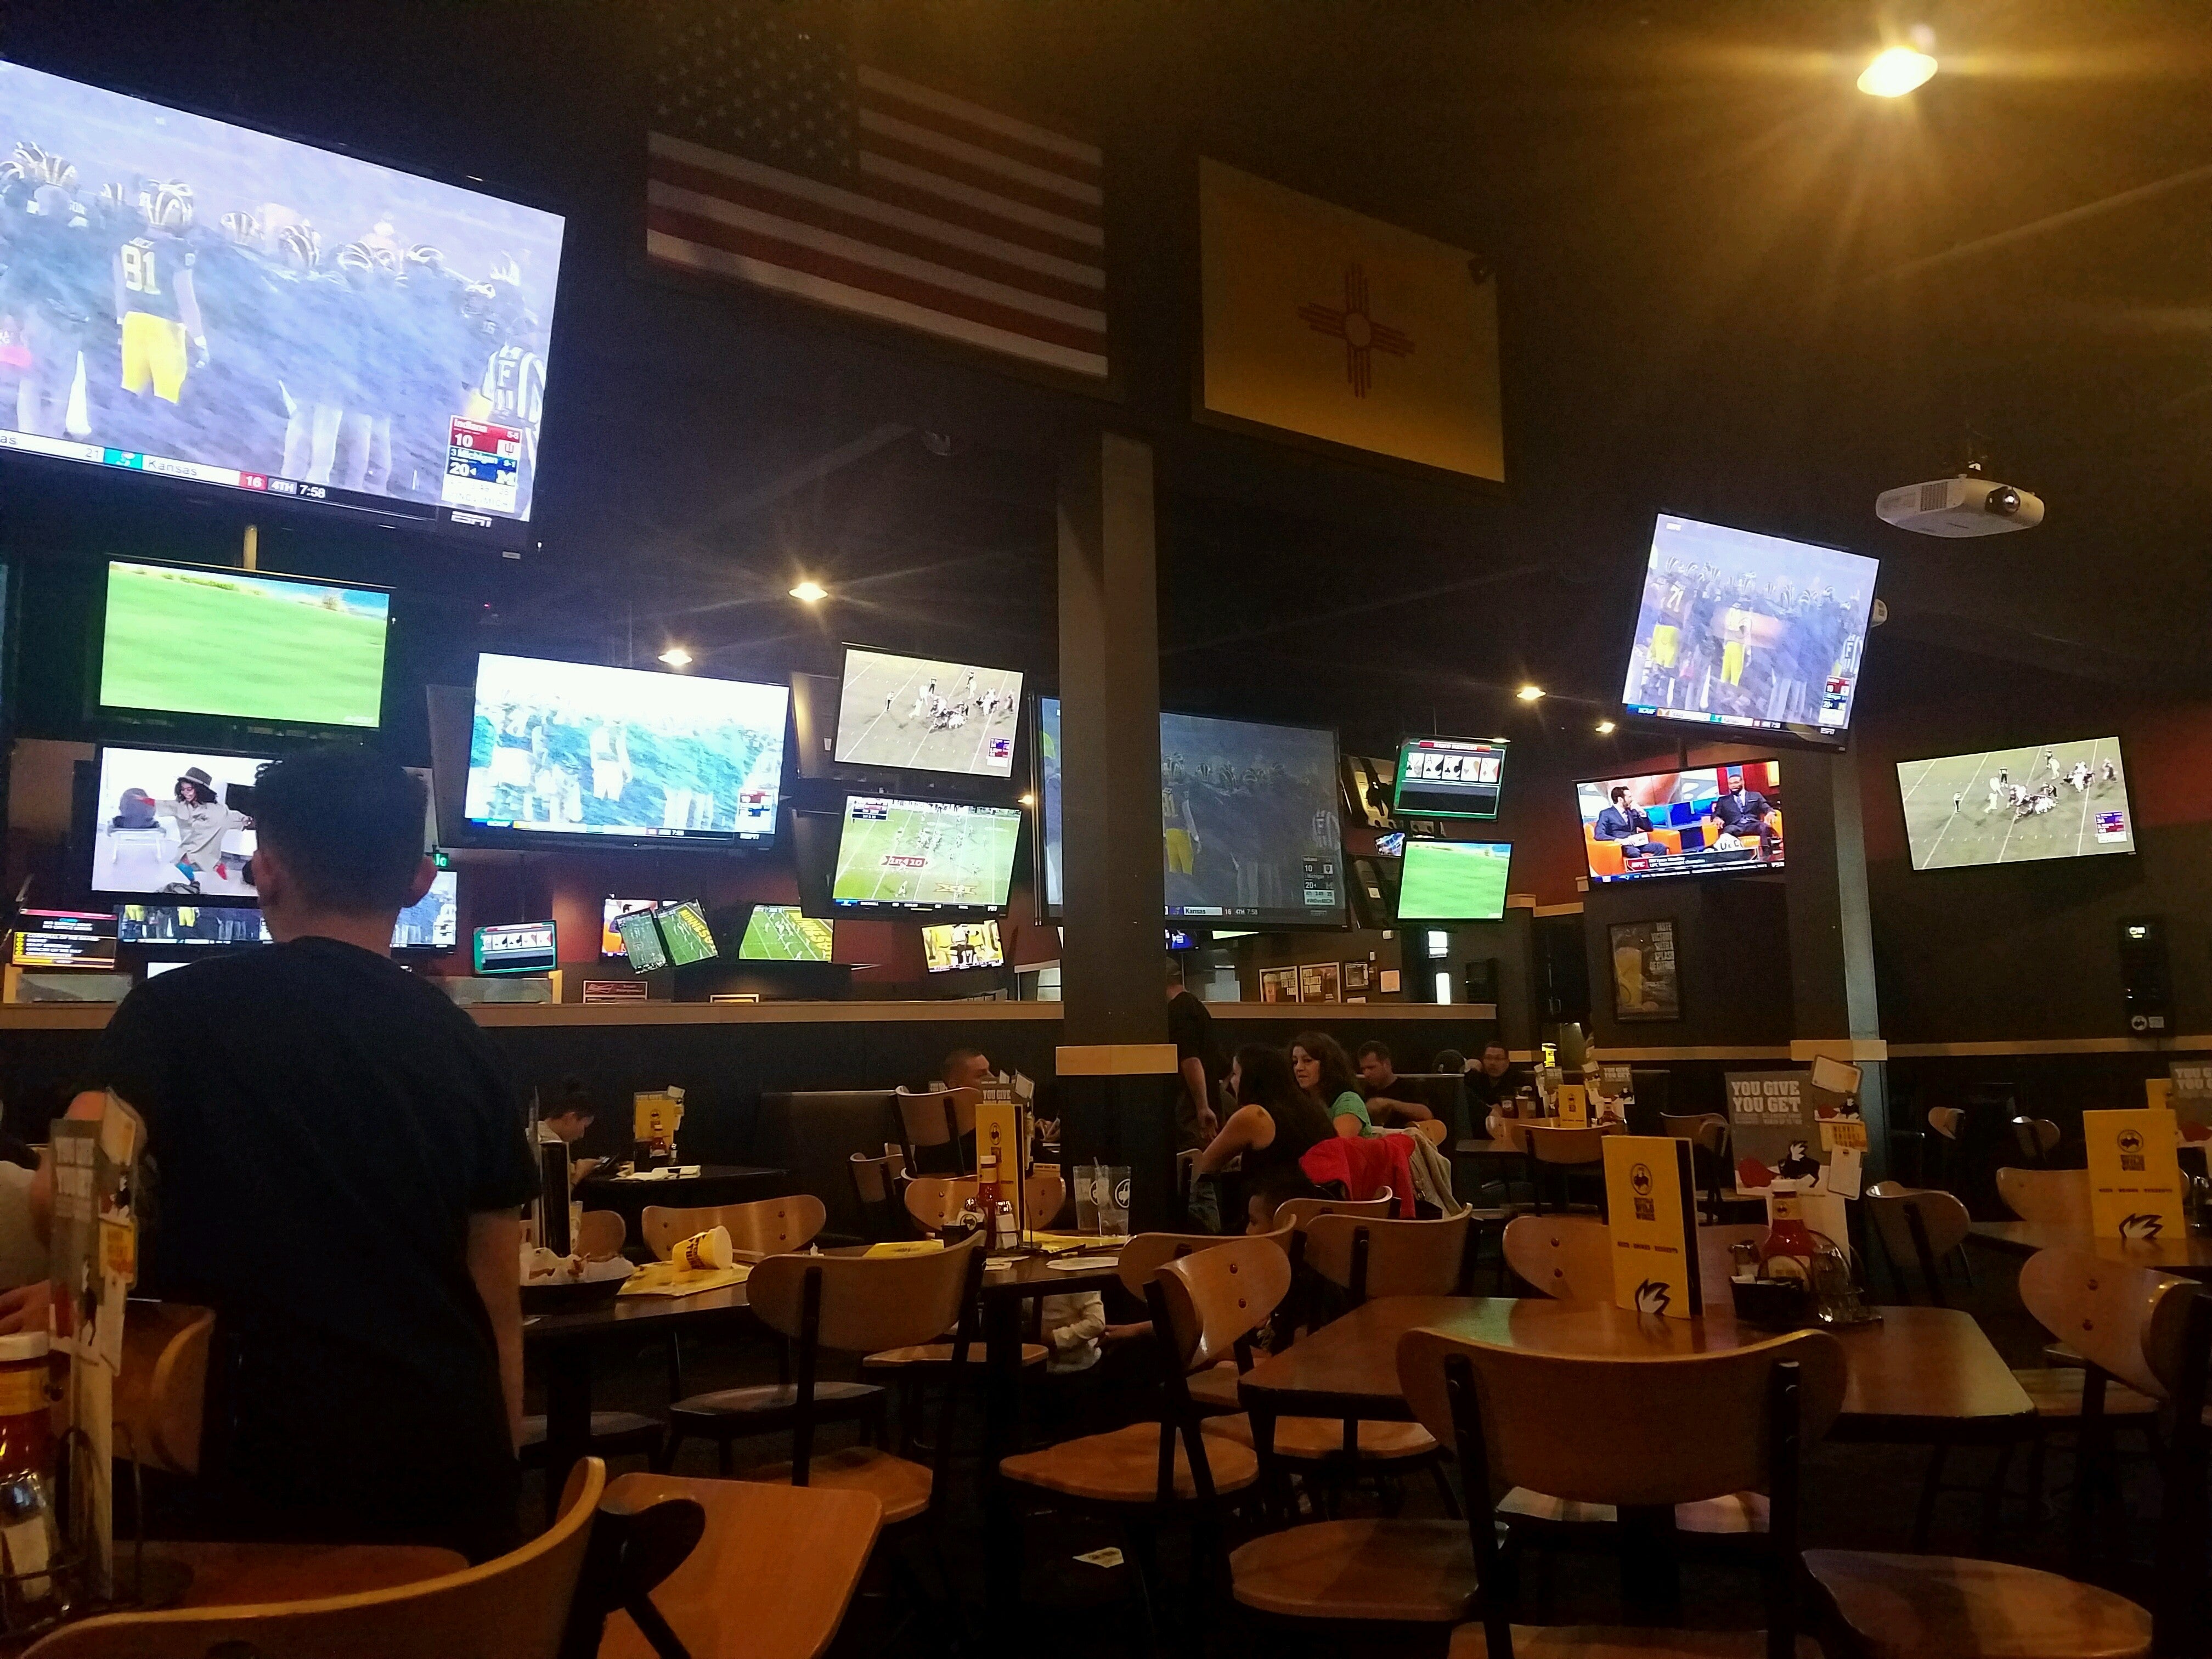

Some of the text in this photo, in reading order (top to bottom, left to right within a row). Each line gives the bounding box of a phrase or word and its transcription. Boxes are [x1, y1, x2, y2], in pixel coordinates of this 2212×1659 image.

[454, 419, 488, 433] Indiana
[455, 433, 473, 448] 10
[85, 448, 100, 459] 21
[458, 449, 499, 465] Michigan
[148, 459, 198, 476] Kansas
[449, 462, 470, 476] 20
[246, 475, 326, 498] 16 4TH 7:58
[983, 1090, 1011, 1100] YOU GIVE
[1731, 1081, 1800, 1096] YOU GIVE
[1733, 1097, 1801, 1113] YOU GET
